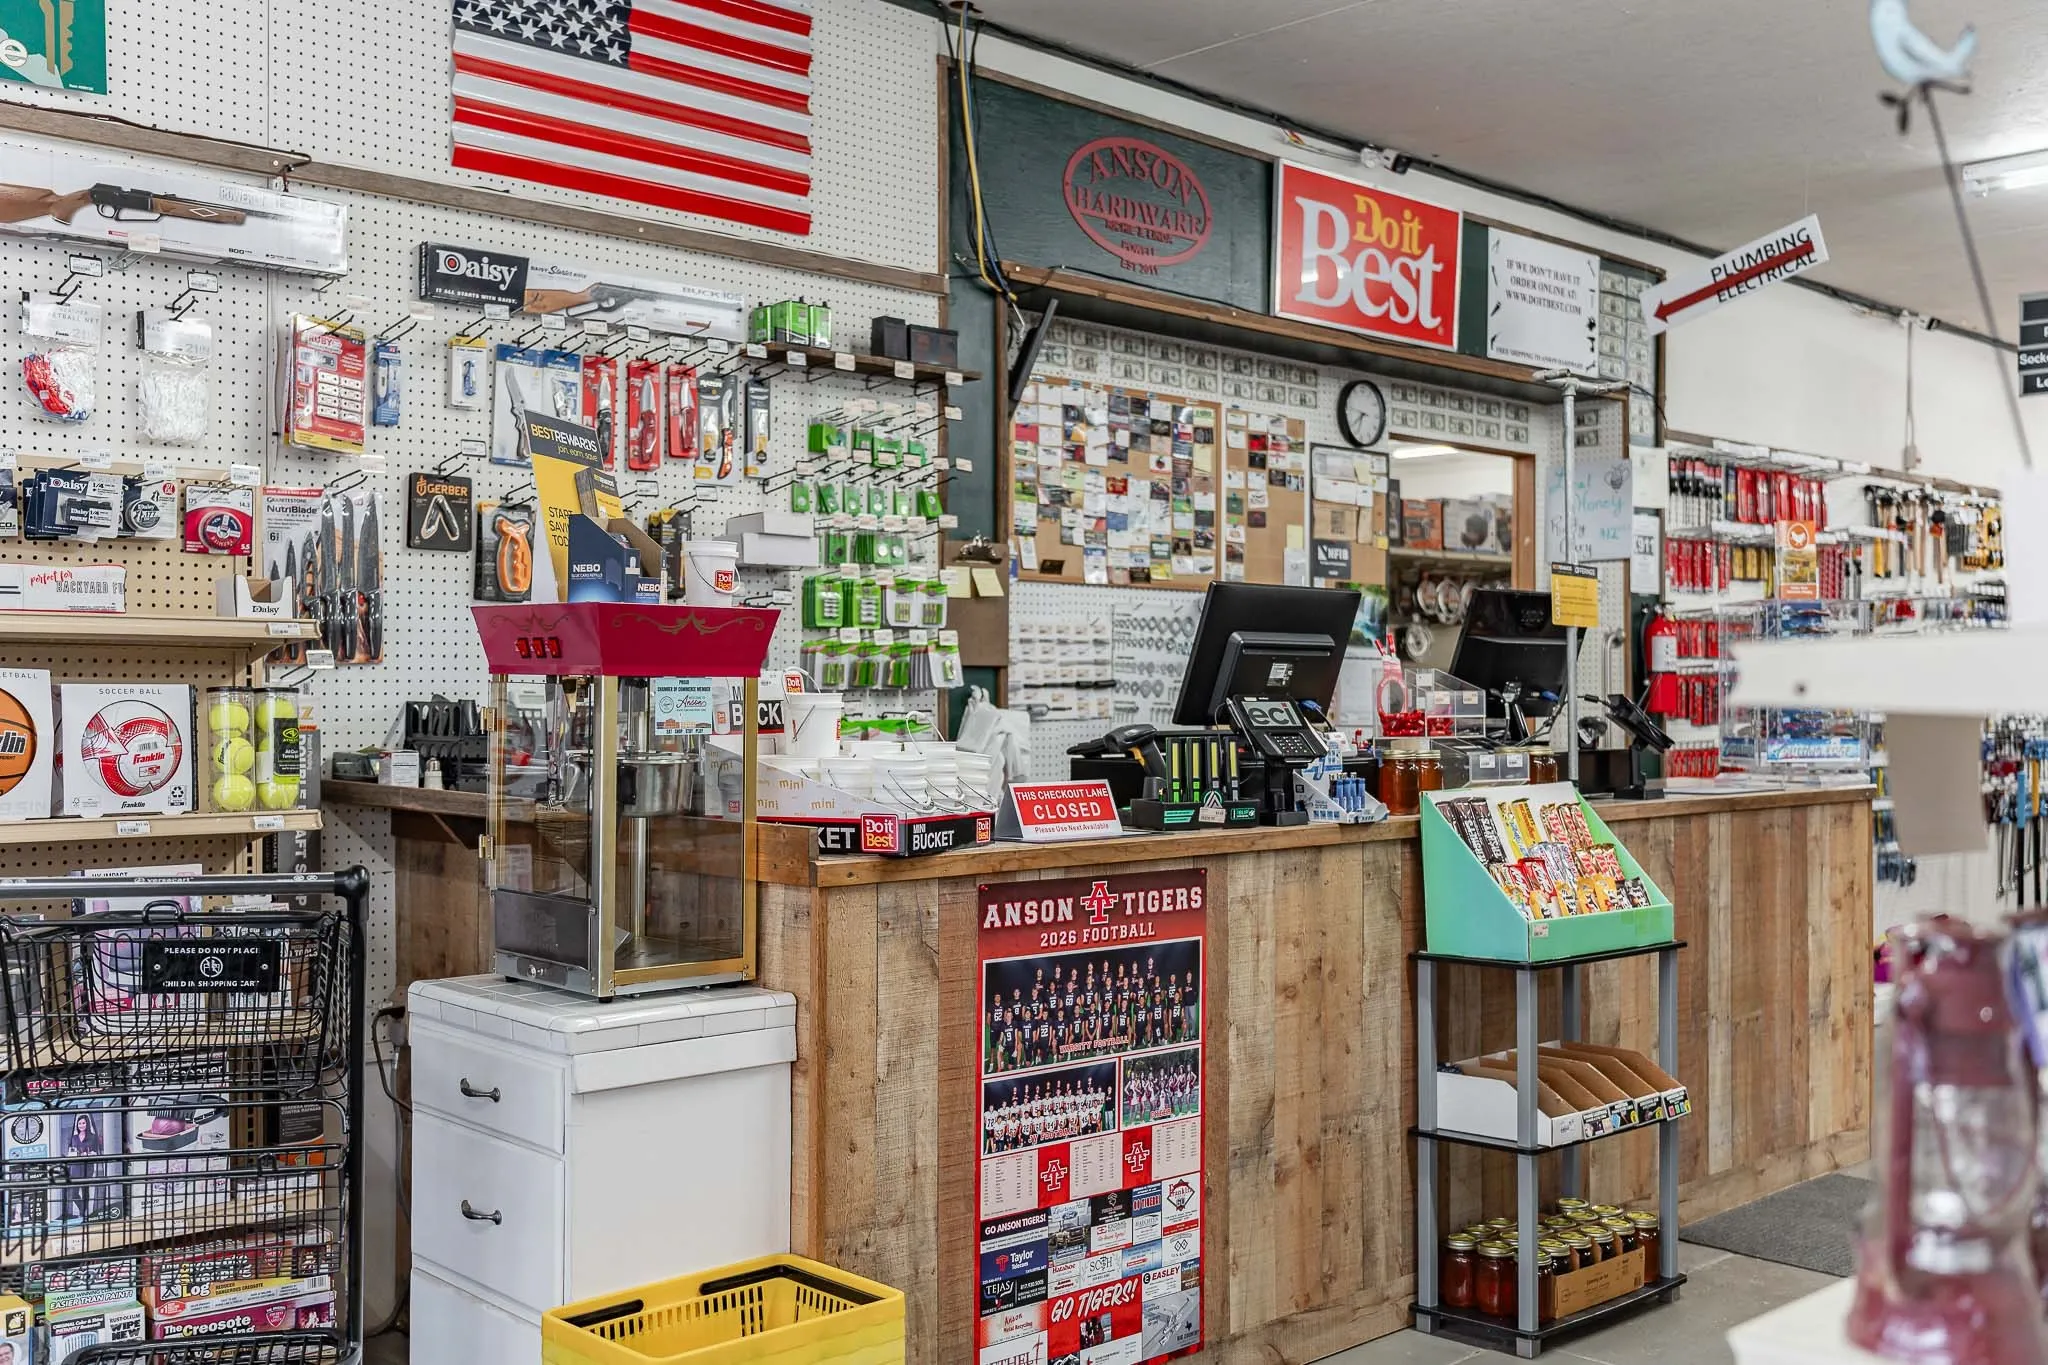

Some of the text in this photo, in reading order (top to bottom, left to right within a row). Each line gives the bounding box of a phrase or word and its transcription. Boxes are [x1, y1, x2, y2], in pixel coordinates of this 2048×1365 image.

[1088, 146, 1196, 207] ANSON
[1074, 185, 1204, 235] HARDWARE
[1352, 193, 1424, 257] Do it
[1709, 226, 1813, 284] PLUMBING
[1294, 195, 1445, 330] Best
[435, 249, 518, 291] Daisy
[1505, 258, 1581, 288] IF WE DON'T HAVE IT
[1716, 250, 1818, 304] ELECTRICAL
[682, 286, 720, 298] BUCK
[1510, 275, 1537, 291] ORDER
[1538, 281, 1566, 298] ONLINE
[456, 290, 480, 299] STARTS
[1505, 288, 1582, 316] WWW.DOITBEST.COM
[1510, 348, 1534, 360] SHIPPING
[49, 477, 87, 494] Daisy
[92, 482, 104, 490] 1/4
[427, 483, 468, 497] GERBER
[70, 507, 89, 517] Daisy
[266, 504, 318, 515] NutriBlade
[269, 532, 276, 541] 6
[240, 543, 251, 551] 5.5
[572, 563, 601, 573] NEBO
[30, 569, 73, 587] perfect for
[55, 580, 109, 594] BACKYARD
[637, 583, 660, 593] NEBO
[251, 604, 280, 616] Daisy
[0, 671, 38, 680] ETBALL
[98, 688, 162, 696] SOCCER BALL
[1249, 702, 1297, 726] eci
[133, 751, 165, 765] Franklin
[779, 778, 804, 791] mini
[1016, 787, 1109, 801] THIS CHECKOUT LANE
[120, 801, 145, 809] Franklin
[810, 799, 835, 810] mini
[1033, 801, 1101, 820] CLOSED
[865, 818, 894, 834] Do it
[912, 824, 926, 835] MINI
[977, 820, 985, 832] Do
[1034, 822, 1109, 834] Please Use Next Available
[866, 834, 895, 849] Best
[912, 830, 955, 851] BUCKET
[977, 830, 990, 841] Best
[982, 896, 1074, 930] ANSON
[1122, 885, 1203, 917] TIGERS
[1039, 921, 1156, 948] 2026 FOOTBALL
[165, 947, 197, 955] PLEASE
[198, 947, 211, 955] DO
[1093, 1034, 1130, 1048] FOOTBALL
[984, 1213, 1047, 1236] GO ANSON TIGERS!
[1010, 1249, 1034, 1263] Taylor
[1011, 1261, 1029, 1270] Telecom
[1151, 1265, 1181, 1281] EASLEY
[182, 1282, 211, 1298] Log
[985, 1280, 1015, 1296] TEJAS
[50, 1290, 133, 1310] EASIER THAN PAINT!
[56, 1293, 76, 1301] AWARD
[1051, 1296, 1075, 1323] GO
[1077, 1278, 1139, 1318] TIGERS!
[110, 1319, 141, 1333] WIPE
[163, 1325, 183, 1336] The
[182, 1315, 252, 1337] Creosote
[1004, 1313, 1023, 1326] Anson
[111, 1330, 140, 1341] NEW
